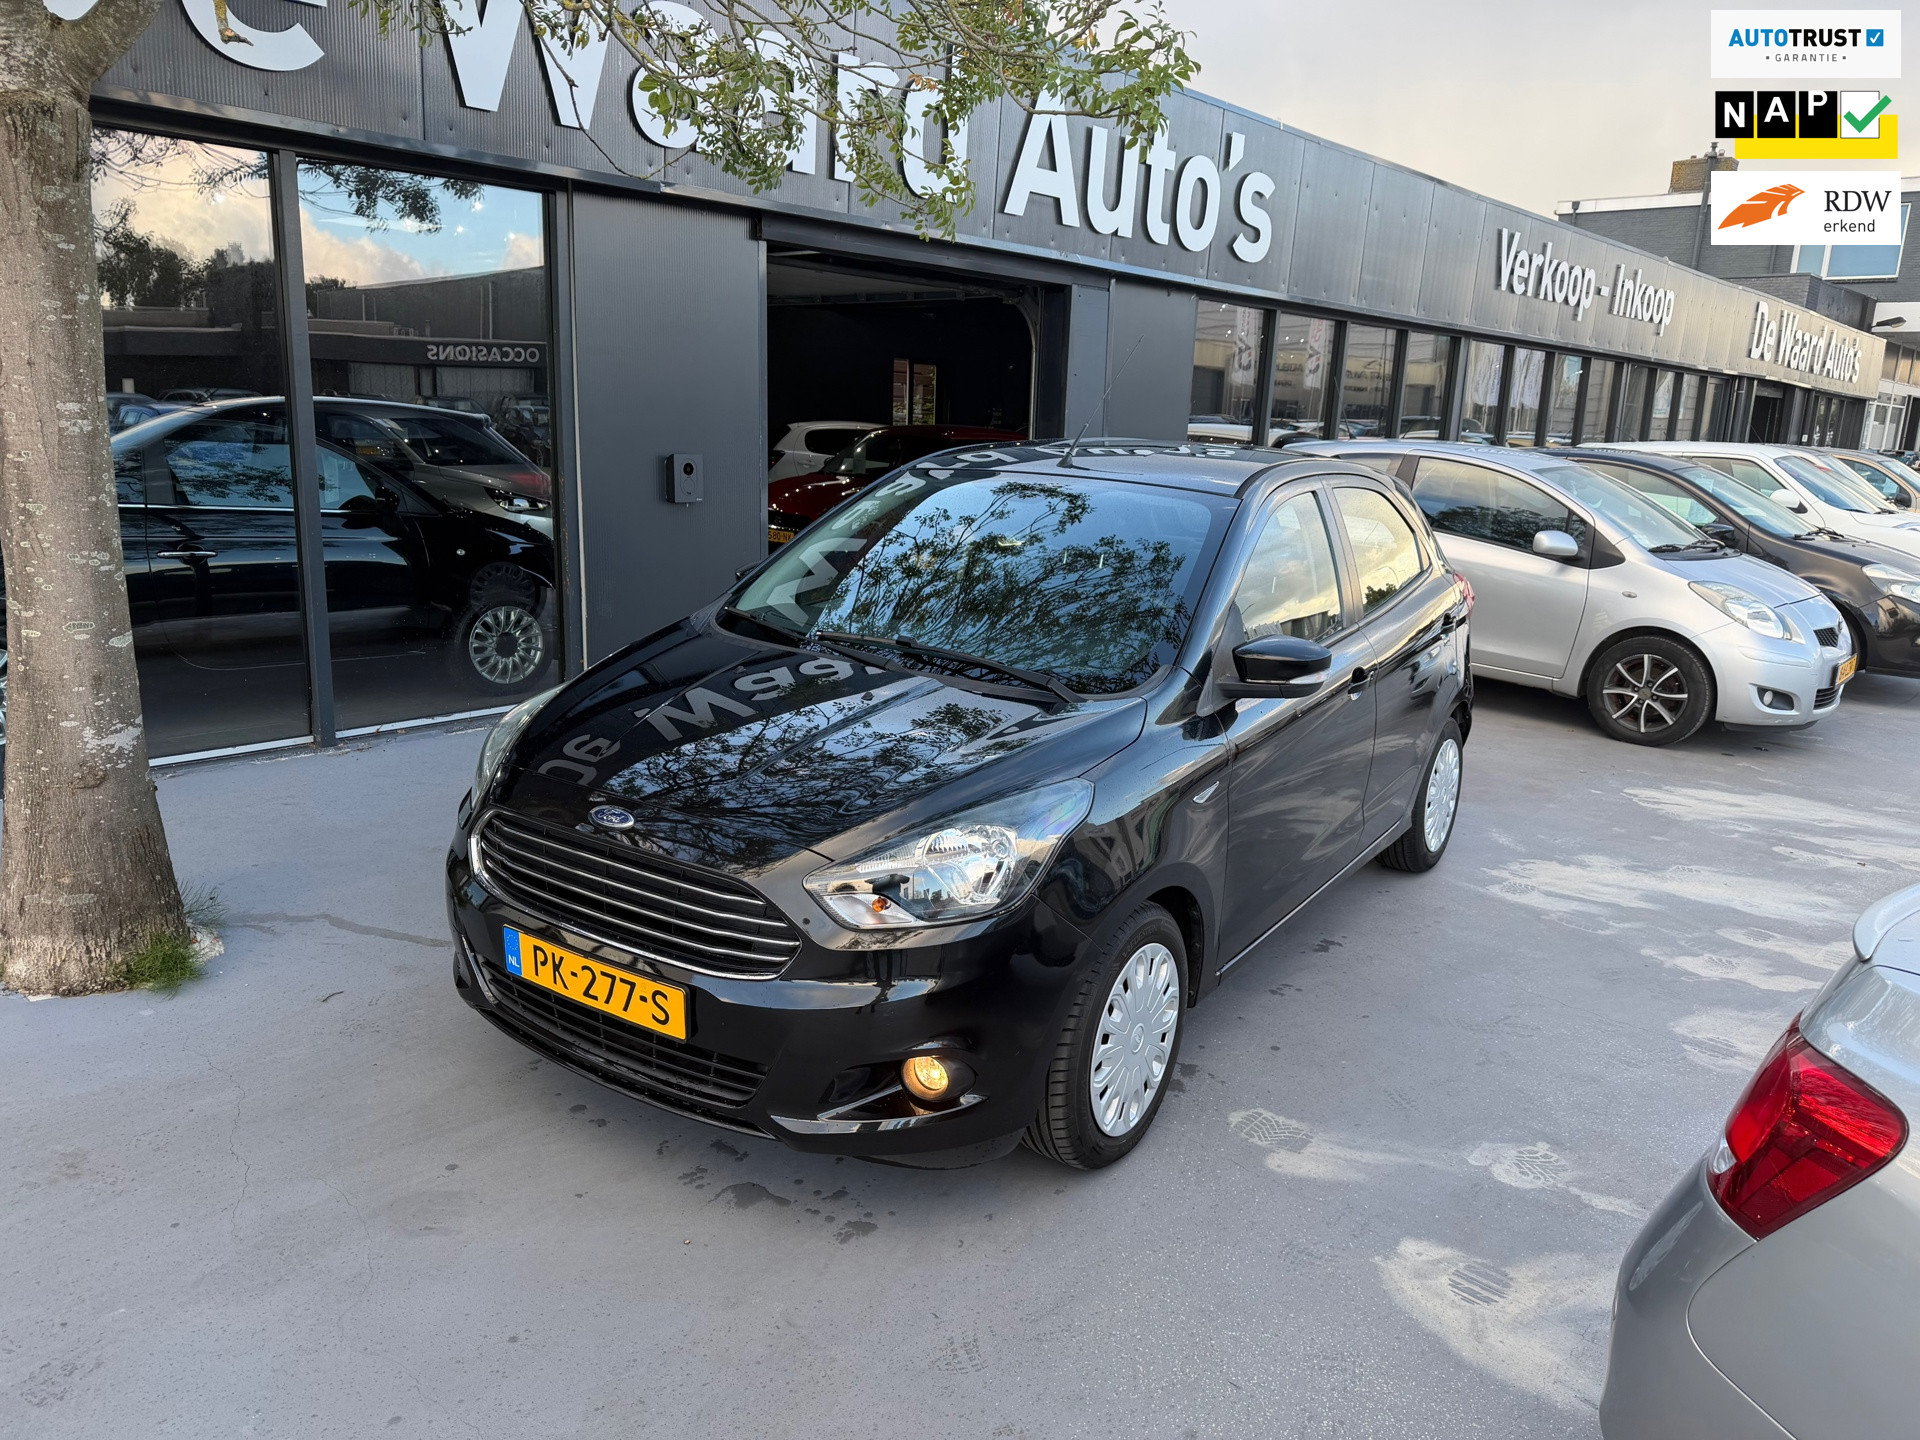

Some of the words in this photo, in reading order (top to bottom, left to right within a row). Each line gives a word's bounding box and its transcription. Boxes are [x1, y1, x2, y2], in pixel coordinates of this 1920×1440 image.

[1003, 75, 1276, 263] Auto's
[1500, 227, 1596, 322] Verkoop
[1612, 263, 1675, 337] Inkoop
[1750, 300, 1777, 362] De
[1777, 309, 1828, 375] Waard
[1823, 328, 1863, 384] Auto's
[598, 809, 625, 823] Ford
[508, 954, 520, 968] NL
[532, 944, 670, 1026] PK-277-S
